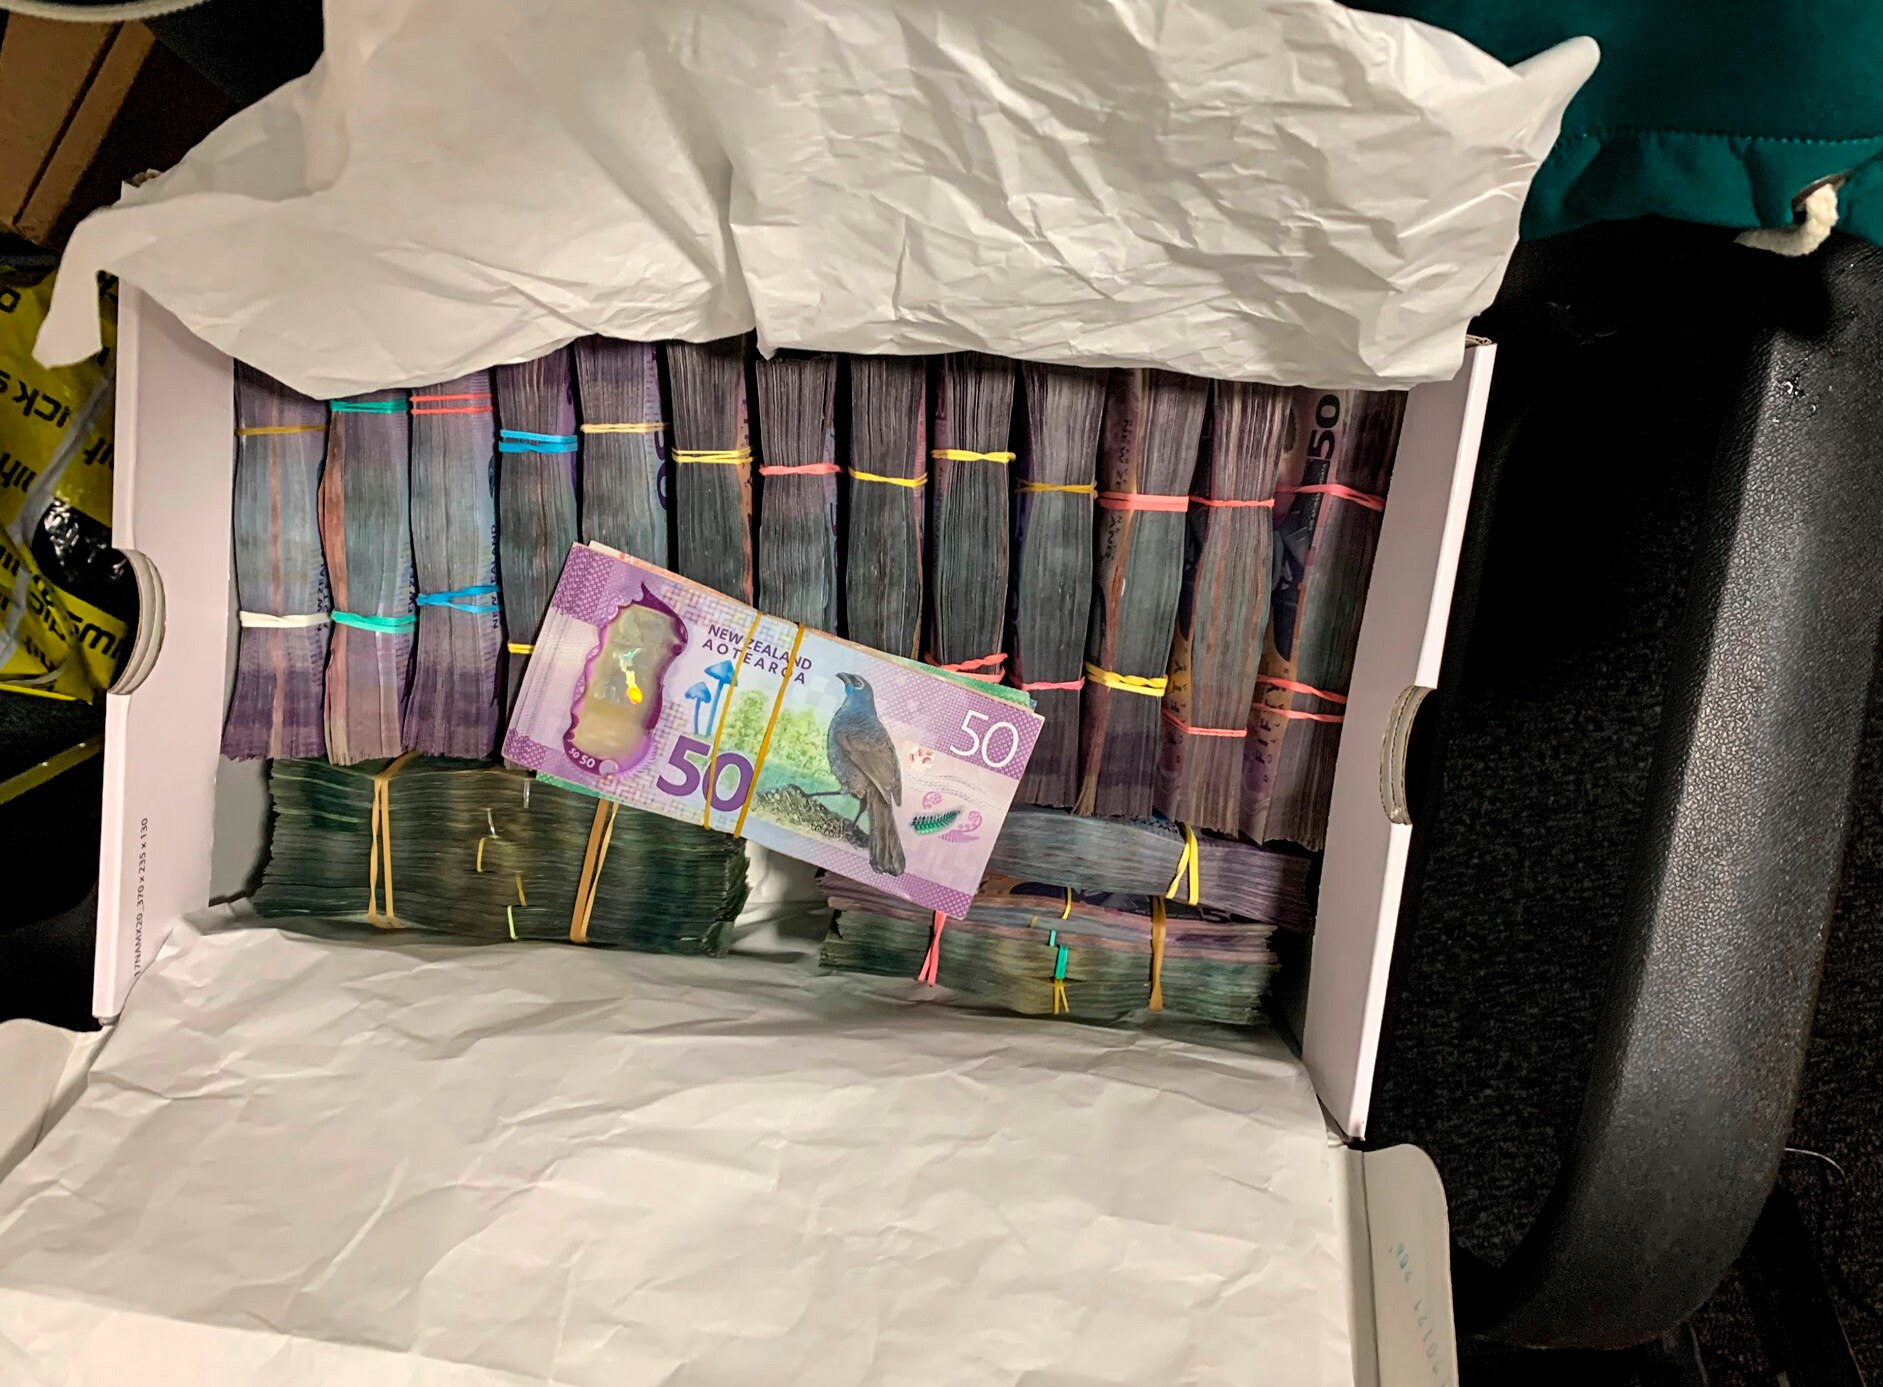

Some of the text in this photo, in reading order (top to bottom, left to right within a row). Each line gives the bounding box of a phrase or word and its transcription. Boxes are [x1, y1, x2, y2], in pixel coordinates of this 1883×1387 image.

[1307, 394, 1341, 460] 50
[707, 624, 812, 670] NEW ZEALAND
[579, 754, 596, 769] 50
[950, 709, 1019, 768] 50
[656, 735, 755, 812] 50
[140, 817, 149, 840] 130
[138, 852, 147, 873] 235
